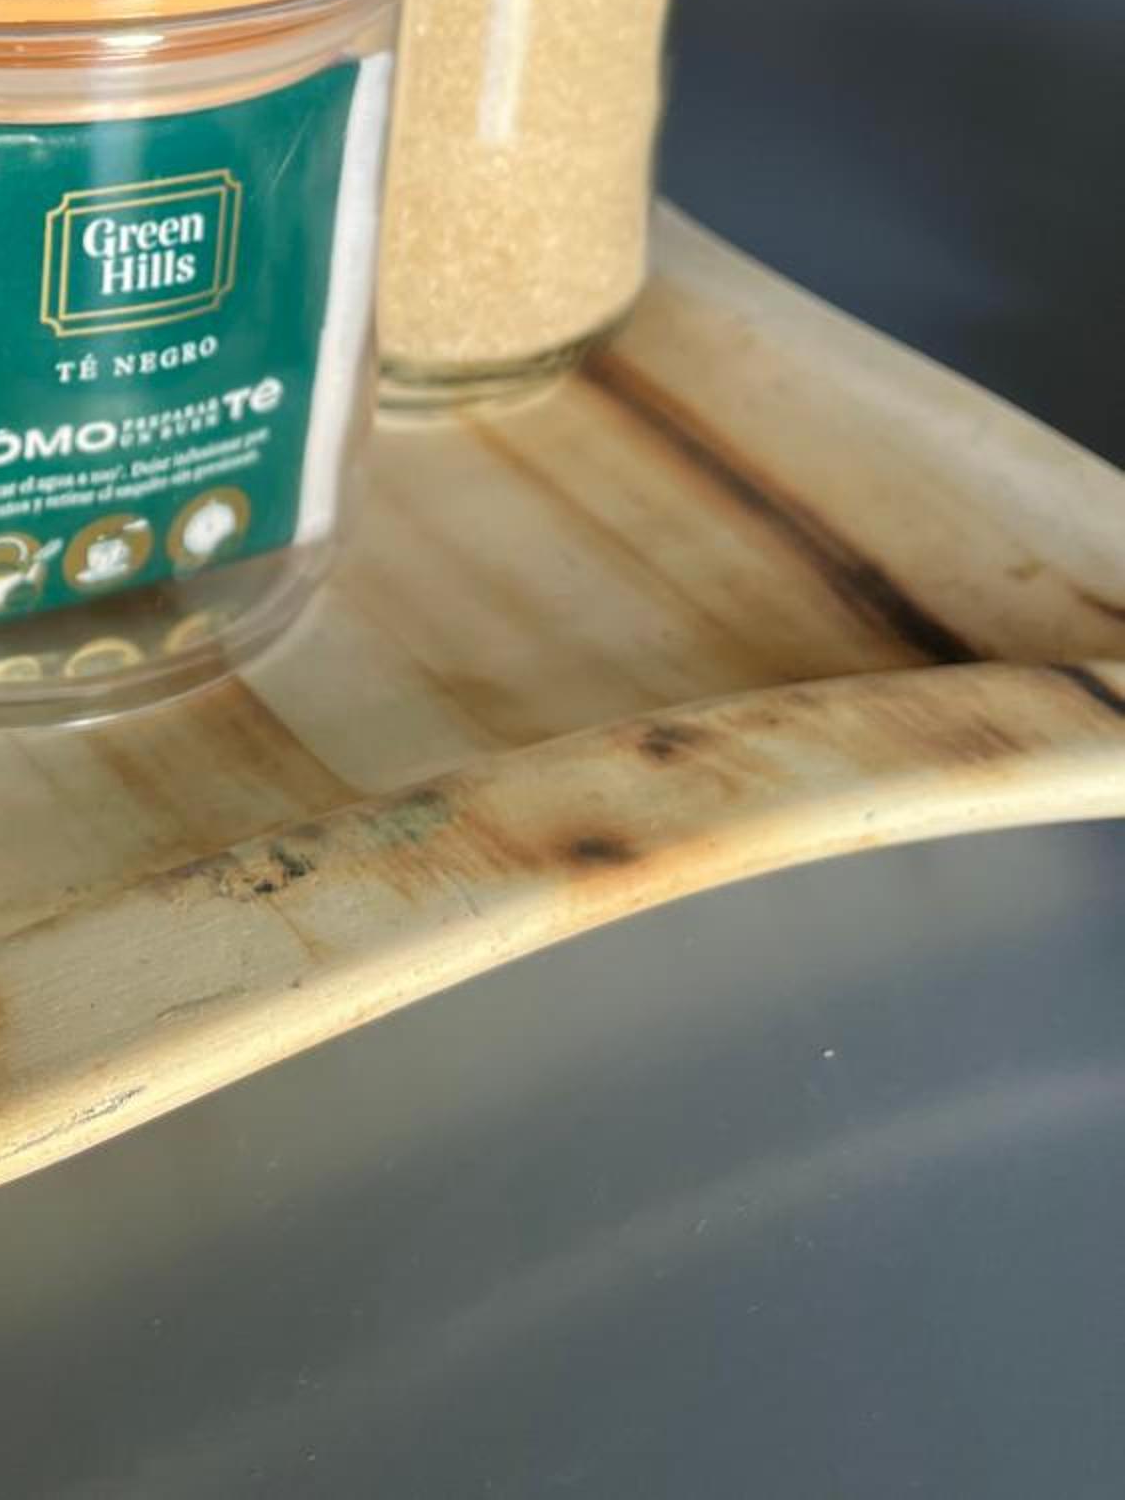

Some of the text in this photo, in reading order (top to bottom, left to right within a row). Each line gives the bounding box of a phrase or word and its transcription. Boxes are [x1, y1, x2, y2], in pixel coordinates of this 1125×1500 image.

[82, 212, 205, 258] Green
[101, 250, 196, 295] Hills
[55, 335, 218, 383] TÉ NEGRO
